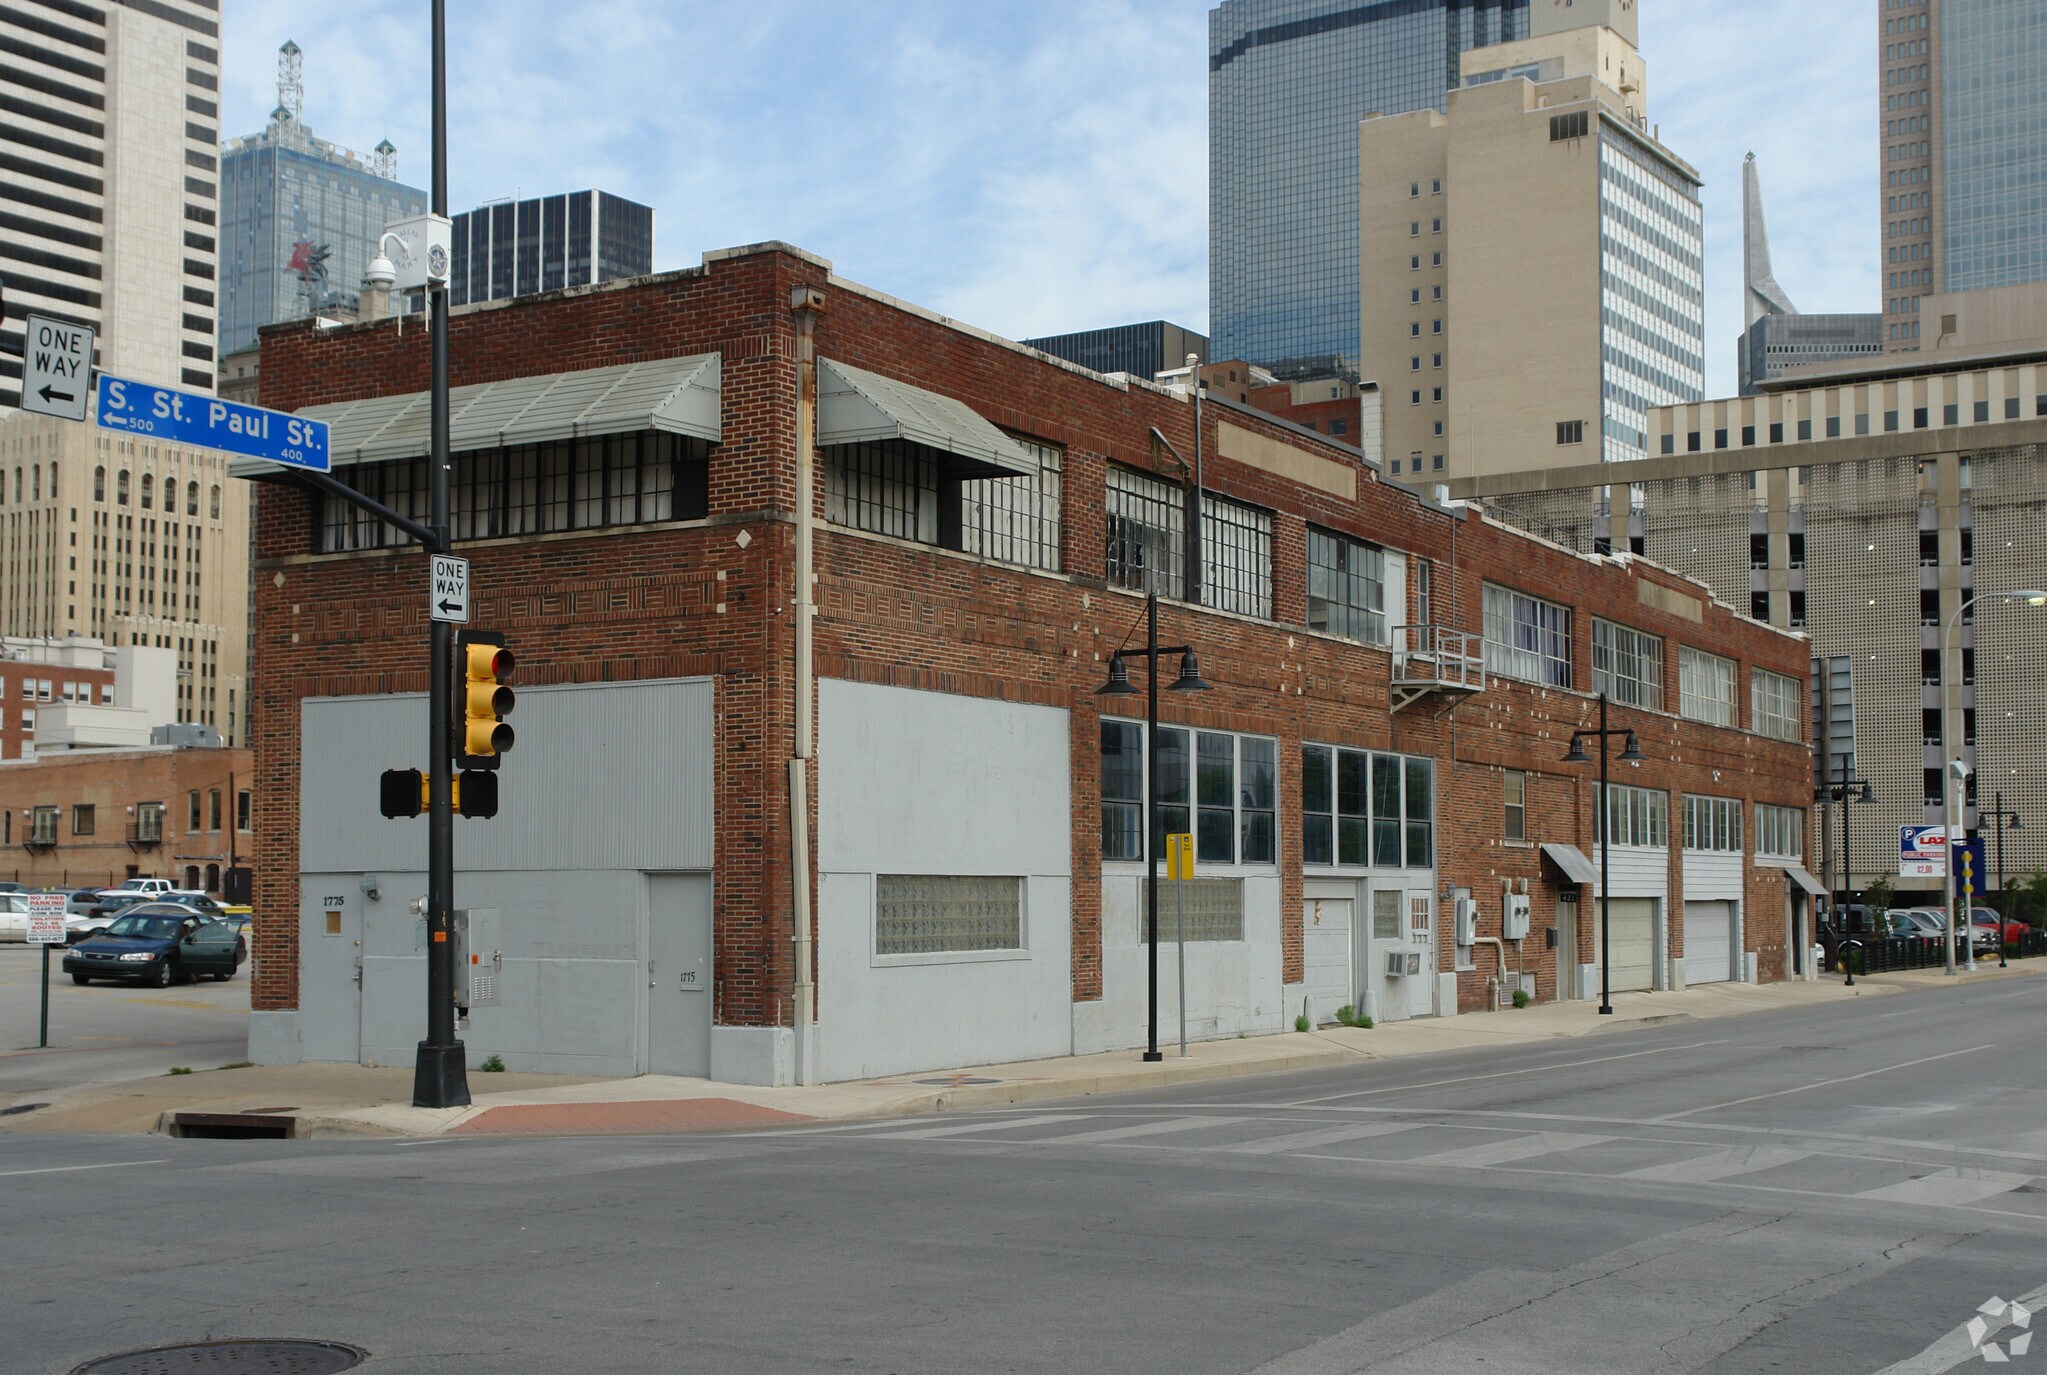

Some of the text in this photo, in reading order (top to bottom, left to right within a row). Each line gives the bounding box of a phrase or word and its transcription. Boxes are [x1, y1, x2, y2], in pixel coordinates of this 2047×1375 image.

[39, 326, 82, 355] ONE
[36, 350, 81, 379] WAY
[107, 381, 322, 450] S. St. Paul St.
[129, 417, 154, 432] 500
[280, 448, 303, 461] 400
[436, 562, 464, 578] ONE
[436, 578, 464, 597] WAY
[323, 896, 345, 906] 1775
[680, 971, 696, 983] 1775
